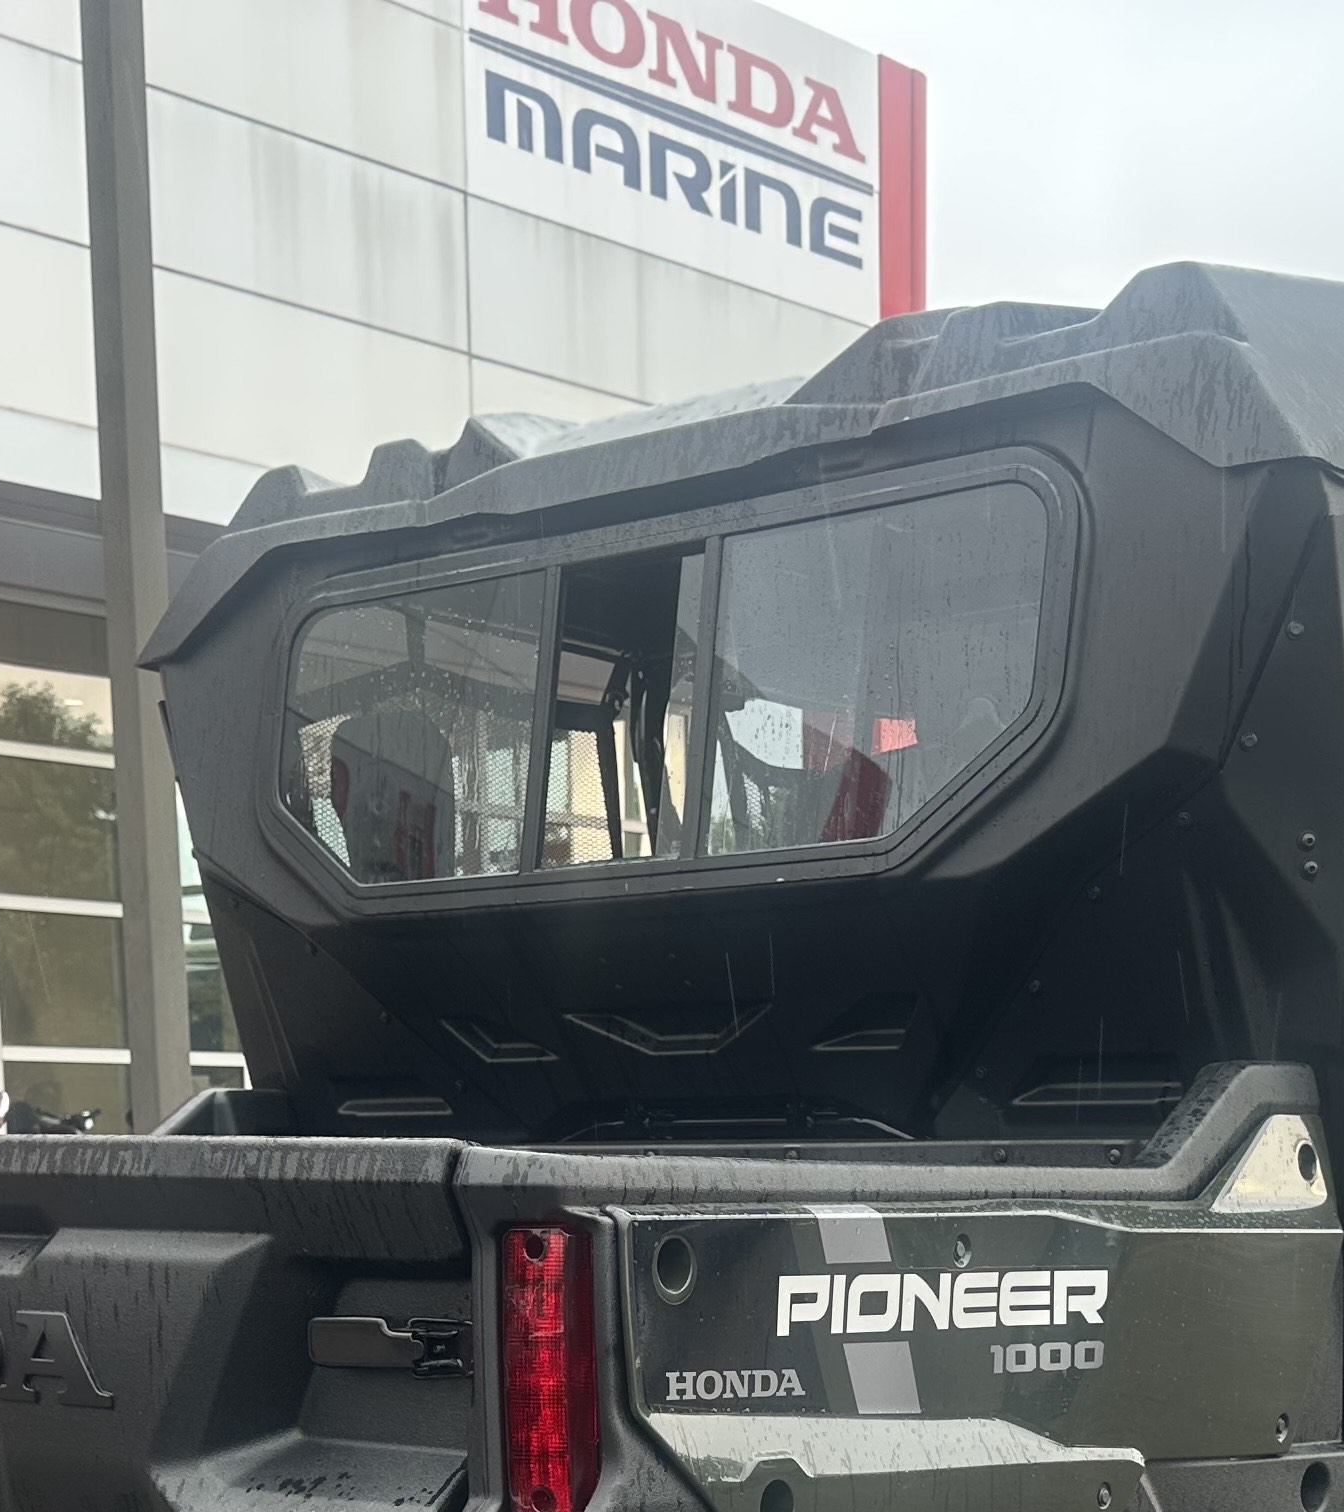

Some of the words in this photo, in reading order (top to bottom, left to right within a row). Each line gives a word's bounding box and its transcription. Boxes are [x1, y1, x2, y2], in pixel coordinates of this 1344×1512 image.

[485, 69, 863, 270] MARINE
[777, 1269, 1108, 1336] PIONEER
[990, 1340, 1104, 1374] 1000
[665, 1368, 805, 1401] HONDA
